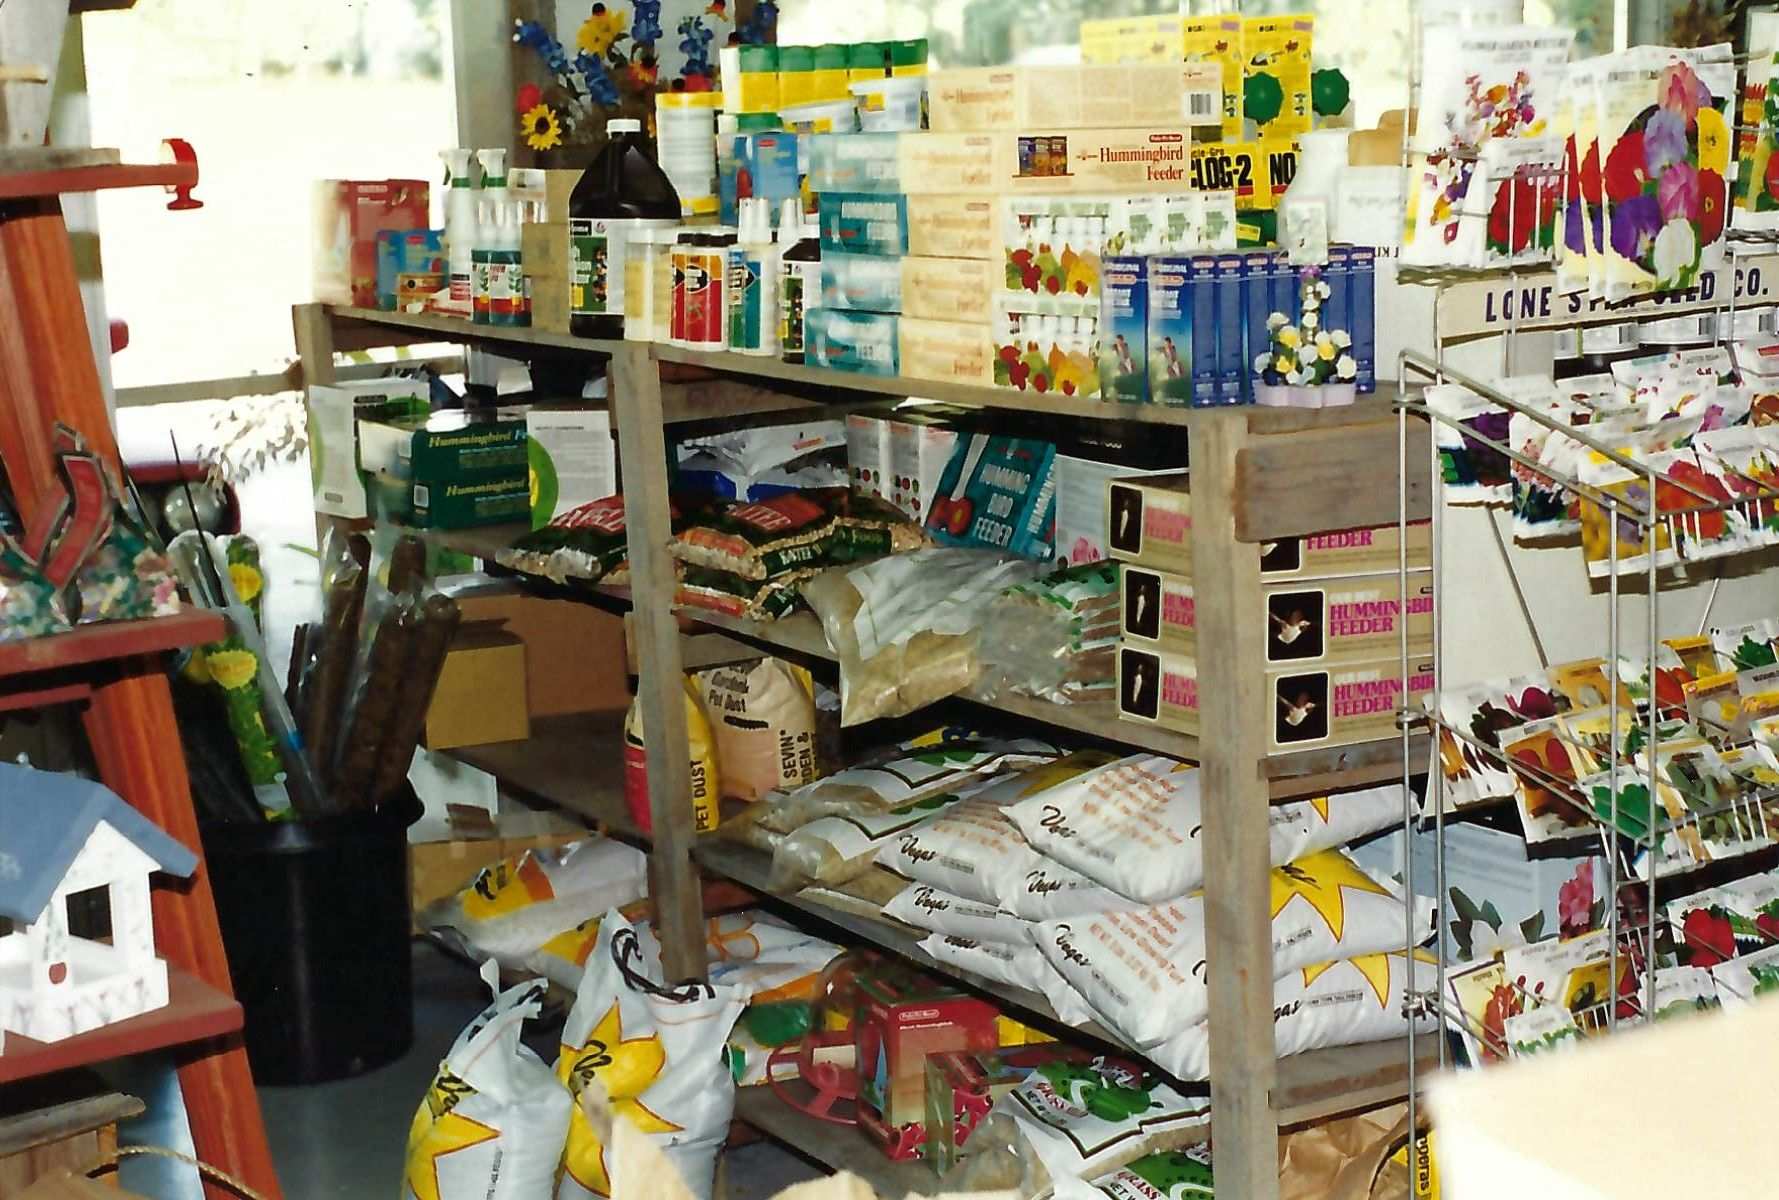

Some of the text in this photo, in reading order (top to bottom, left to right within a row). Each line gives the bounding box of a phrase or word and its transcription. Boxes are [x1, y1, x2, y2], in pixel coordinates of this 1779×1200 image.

[1100, 145, 1184, 163] Hummingbird
[1147, 165, 1185, 181] Feeder
[1485, 286, 1552, 322] LONE
[429, 431, 512, 448] Hummingbird
[972, 516, 1013, 547] FEEDER
[1307, 529, 1373, 550] FEEDER
[1329, 597, 1433, 621] HUMMINBI
[1329, 617, 1393, 637] FEEDER
[1334, 674, 1435, 700] HUMMINBI
[1334, 696, 1393, 717] FEEDER
[690, 760, 709, 832] PET DUST
[899, 833, 937, 864] Vegas
[1025, 870, 1063, 897] Vegas
[914, 886, 951, 915] Vegas
[1055, 923, 1092, 967] Vegas
